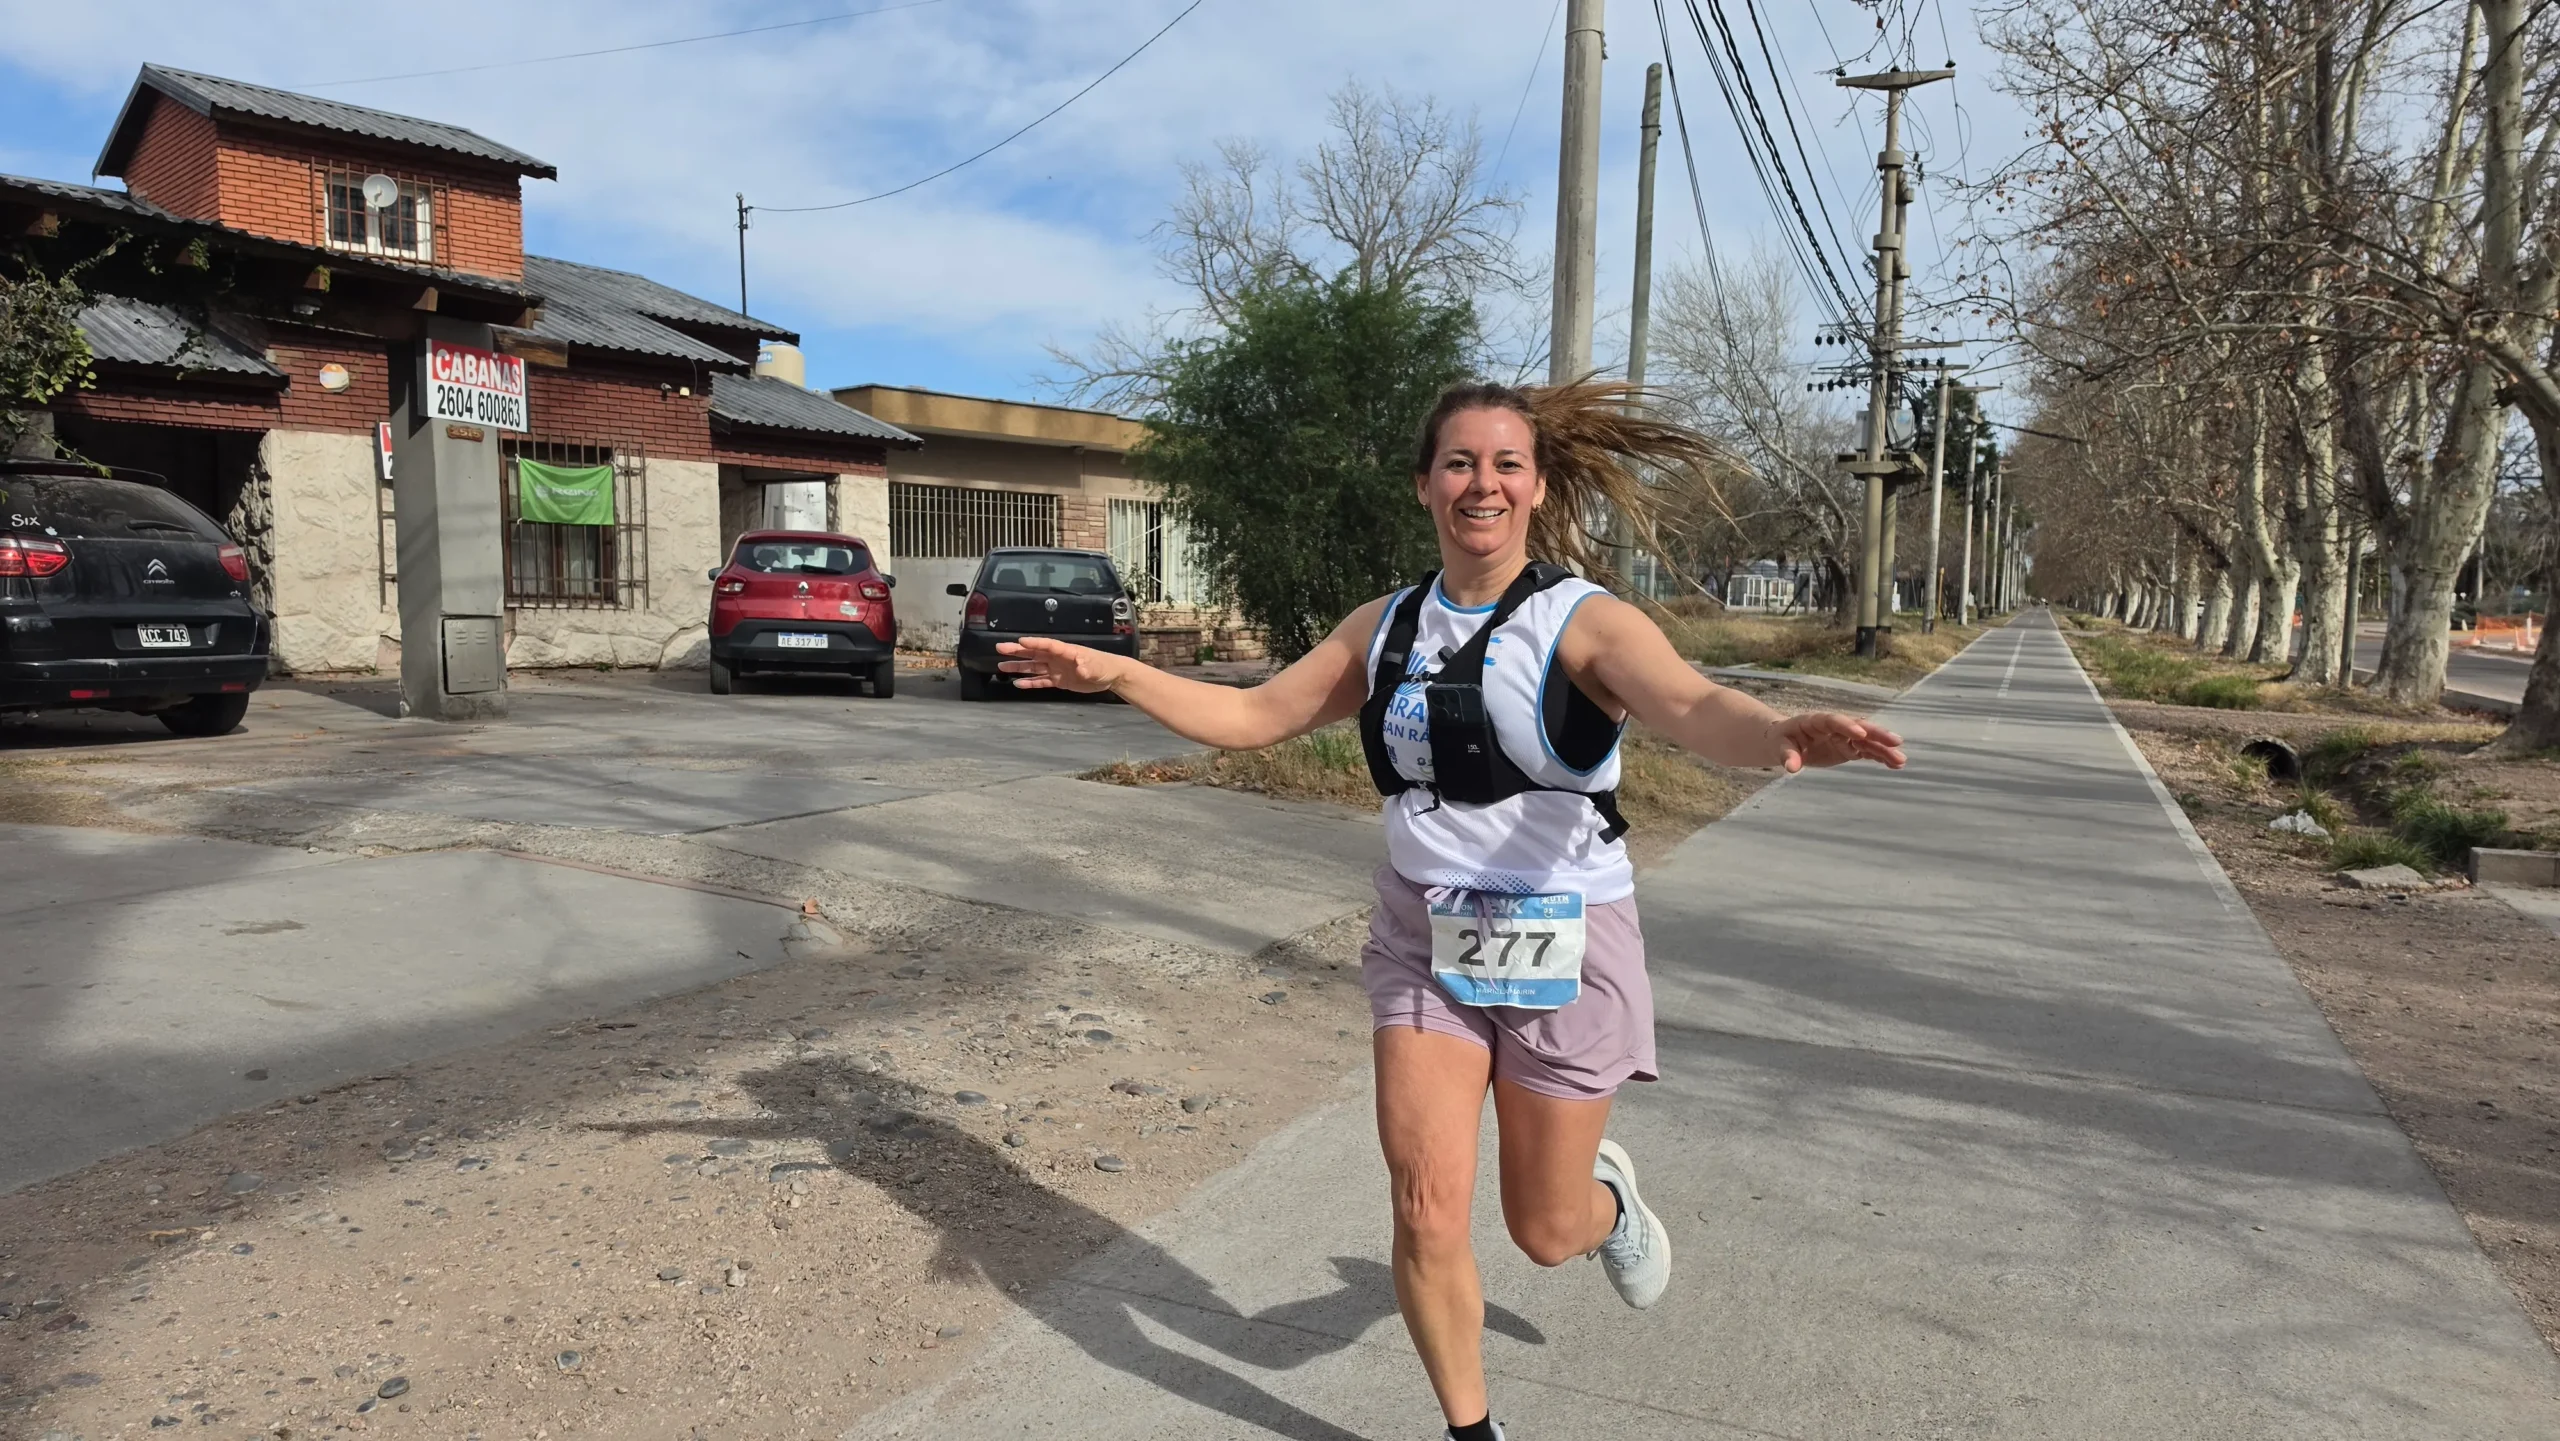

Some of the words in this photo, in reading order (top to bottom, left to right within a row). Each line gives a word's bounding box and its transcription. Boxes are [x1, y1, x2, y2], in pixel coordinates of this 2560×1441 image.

[436, 349, 521, 394] CABAÑAS
[437, 384, 473, 419] 2604
[478, 391, 521, 428] 600863
[140, 629, 163, 642] KCC
[166, 629, 188, 642] 743
[781, 637, 792, 646] AE
[795, 637, 812, 646] 317
[814, 638, 826, 647] VP
[1458, 929, 1556, 967] 277
